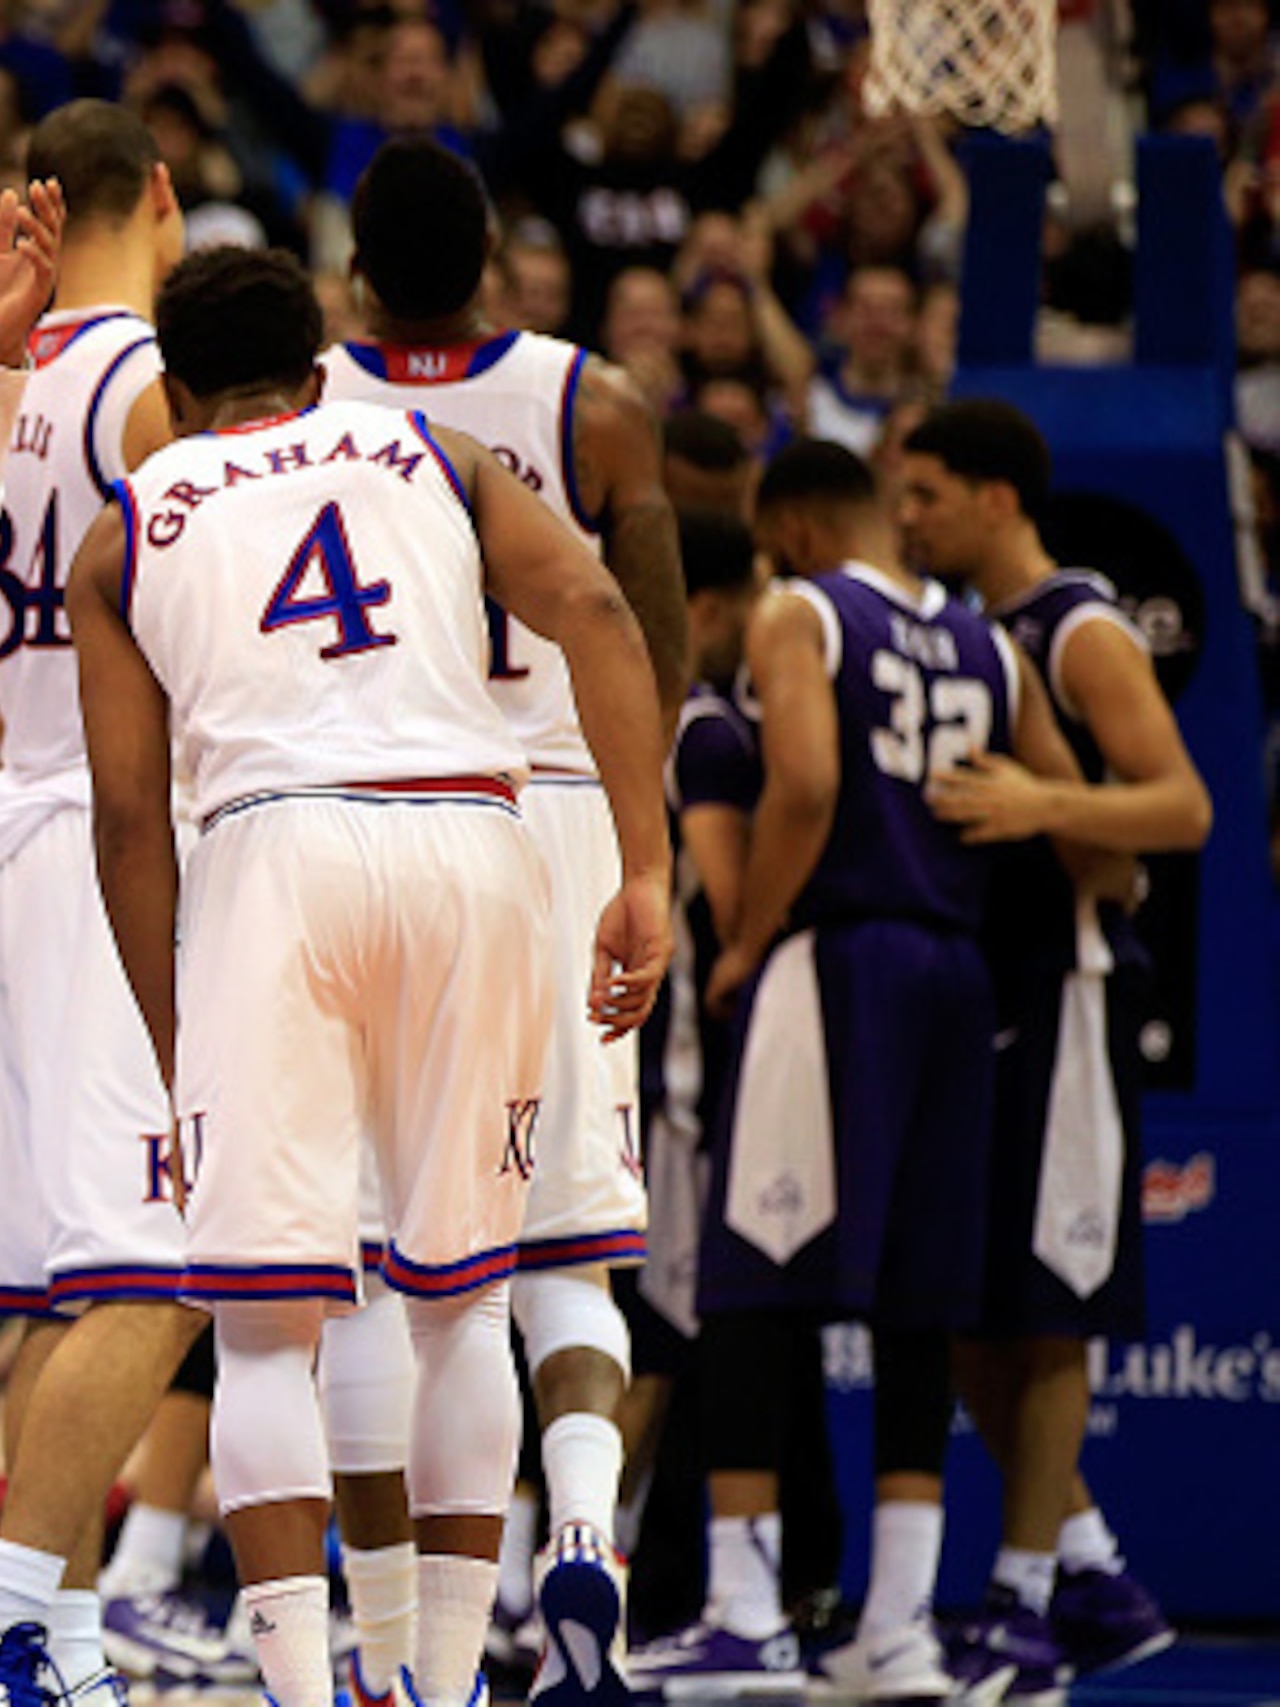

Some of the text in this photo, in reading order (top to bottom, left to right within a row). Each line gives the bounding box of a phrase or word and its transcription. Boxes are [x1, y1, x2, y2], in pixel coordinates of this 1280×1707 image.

[146, 432, 424, 550] GRAHAM
[259, 500, 397, 660] 4
[869, 648, 991, 790] 32
